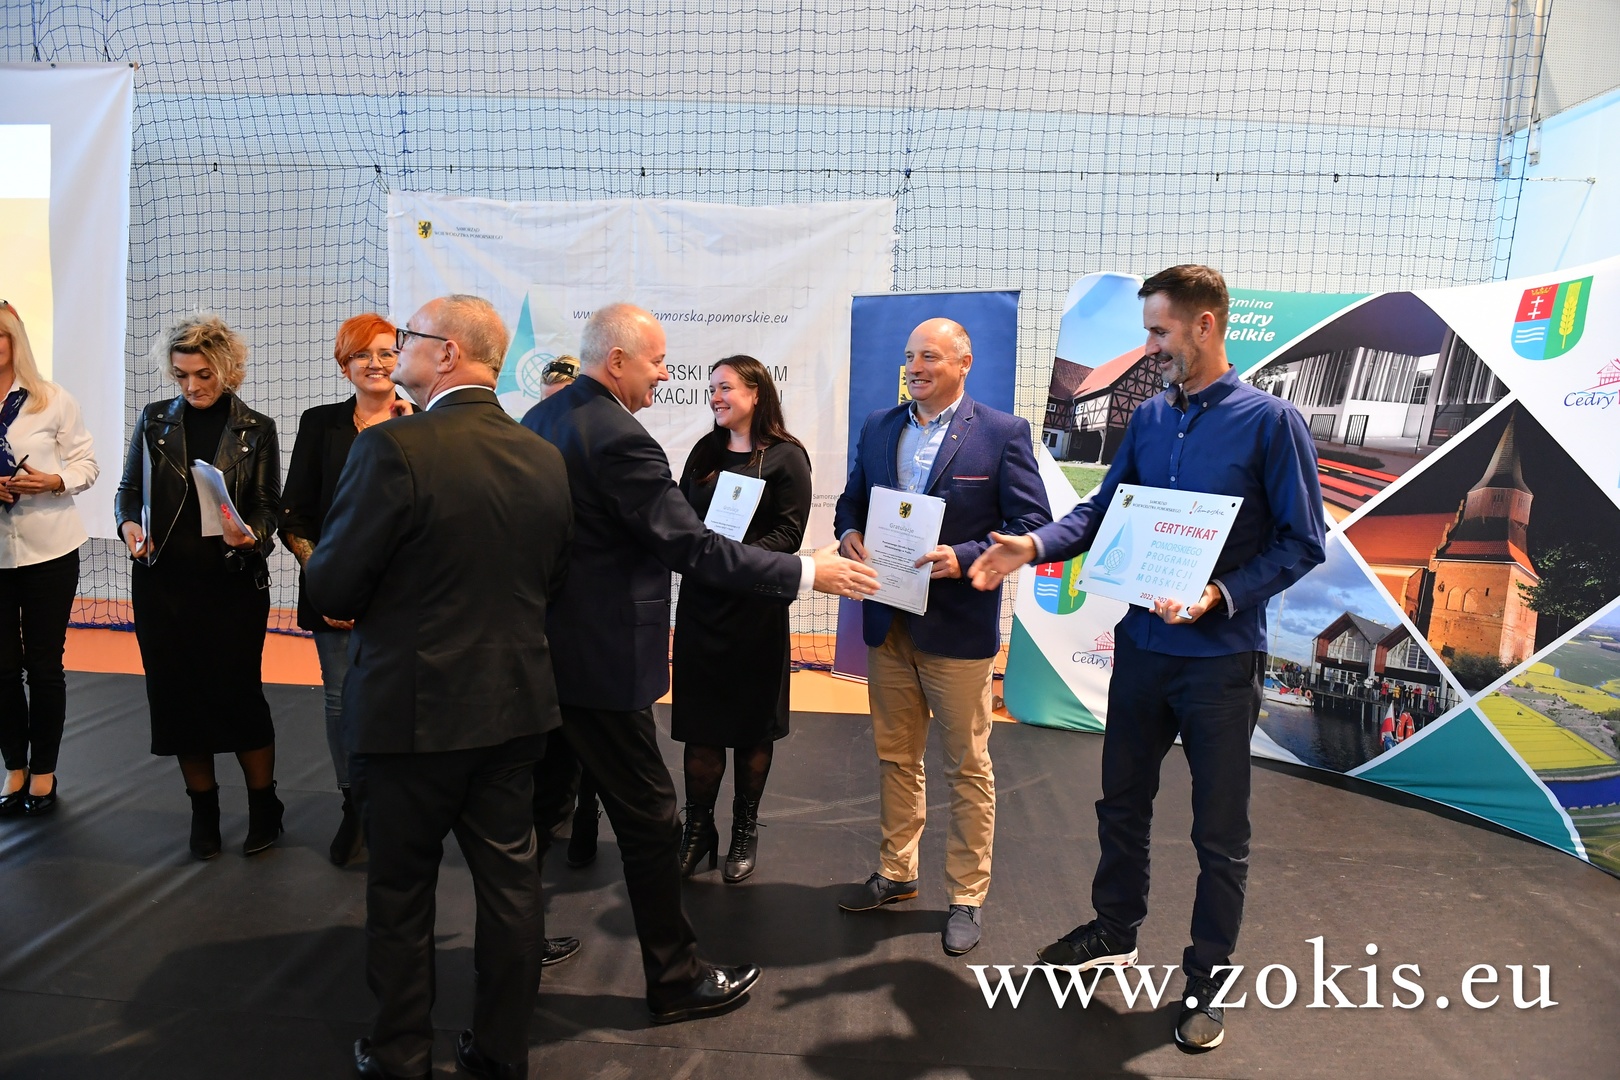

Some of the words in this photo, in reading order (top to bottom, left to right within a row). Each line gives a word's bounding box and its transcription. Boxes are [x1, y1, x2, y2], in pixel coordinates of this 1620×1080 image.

[1228, 311, 1274, 327] edry
[1224, 326, 1276, 342] ielkie
[1563, 391, 1614, 409] Cedry
[1154, 521, 1218, 541] CERTYFIKAT
[1151, 540, 1203, 556] POMORSKIEGO
[1145, 550, 1198, 568] PROGRAMU
[1140, 561, 1193, 580] EDUKACJI
[1135, 573, 1188, 592] MORSKIEJ
[1139, 592, 1153, 601] 2022
[1072, 651, 1108, 669] Cedry
